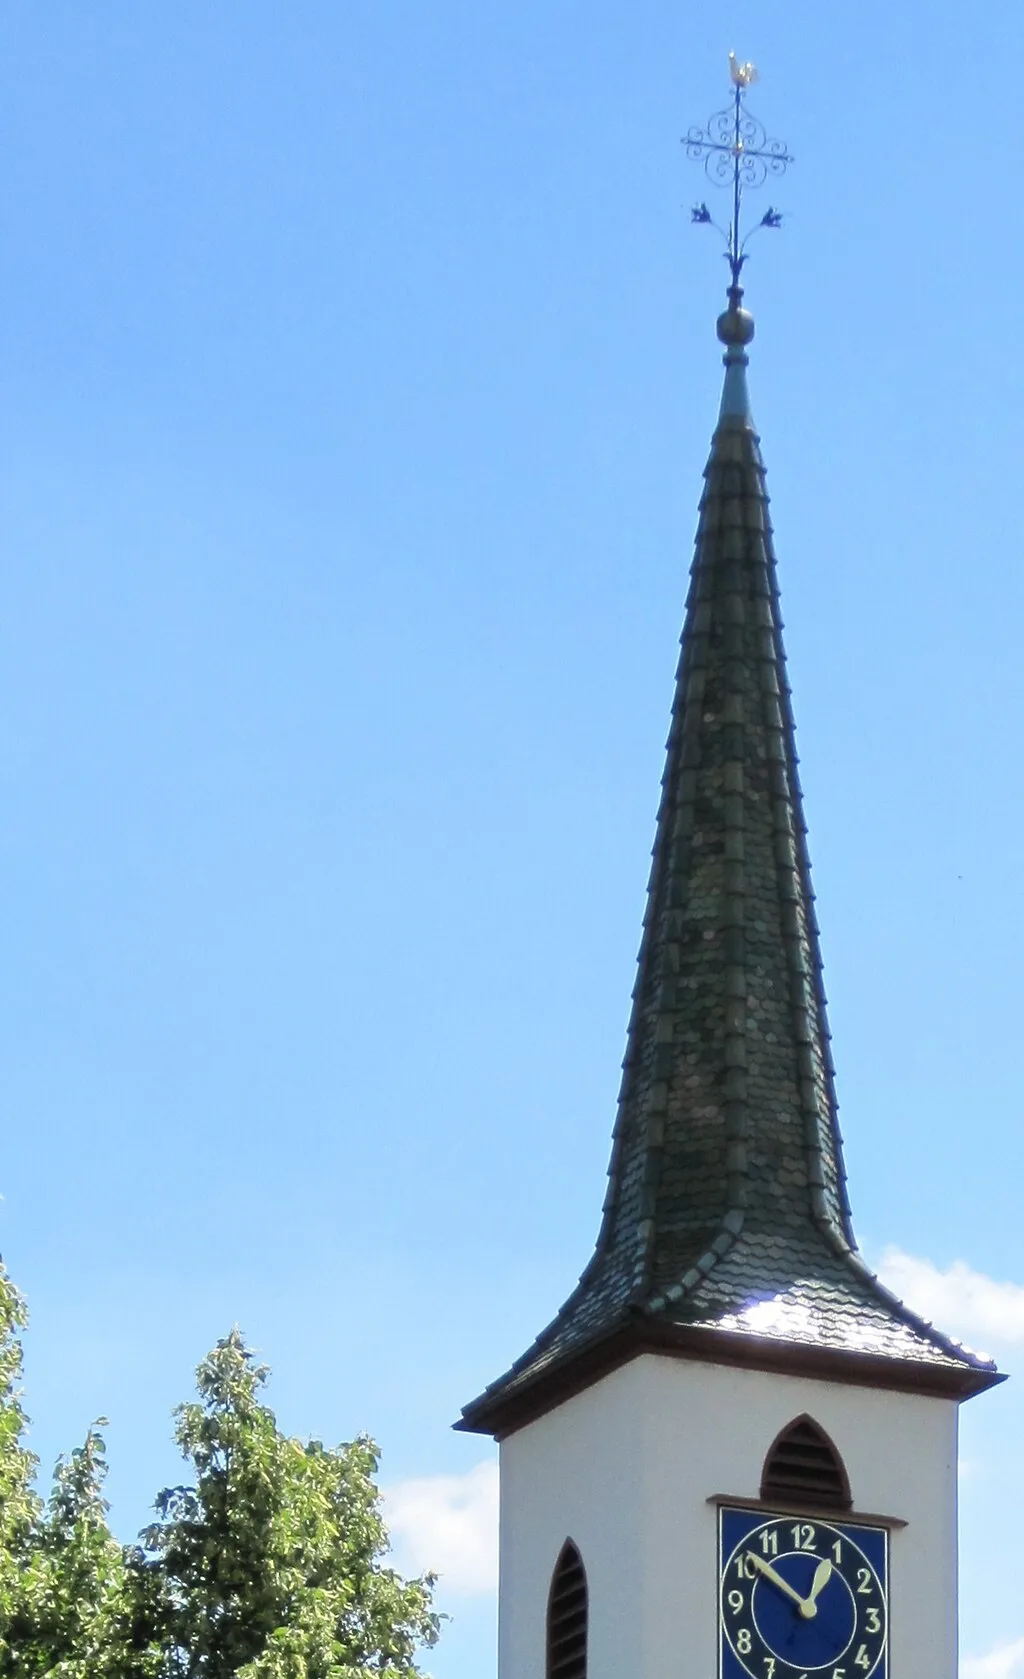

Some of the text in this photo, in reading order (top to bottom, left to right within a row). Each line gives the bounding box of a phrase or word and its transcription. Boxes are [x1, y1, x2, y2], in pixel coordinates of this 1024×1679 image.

[759, 1530, 778, 1555] 11
[791, 1525, 818, 1550] 12
[832, 1540, 841, 1564] 1
[858, 1569, 872, 1593] 2
[728, 1591, 743, 1615] 9
[865, 1608, 881, 1633] 3
[737, 1629, 751, 1654] 8
[855, 1644, 870, 1669] 4
